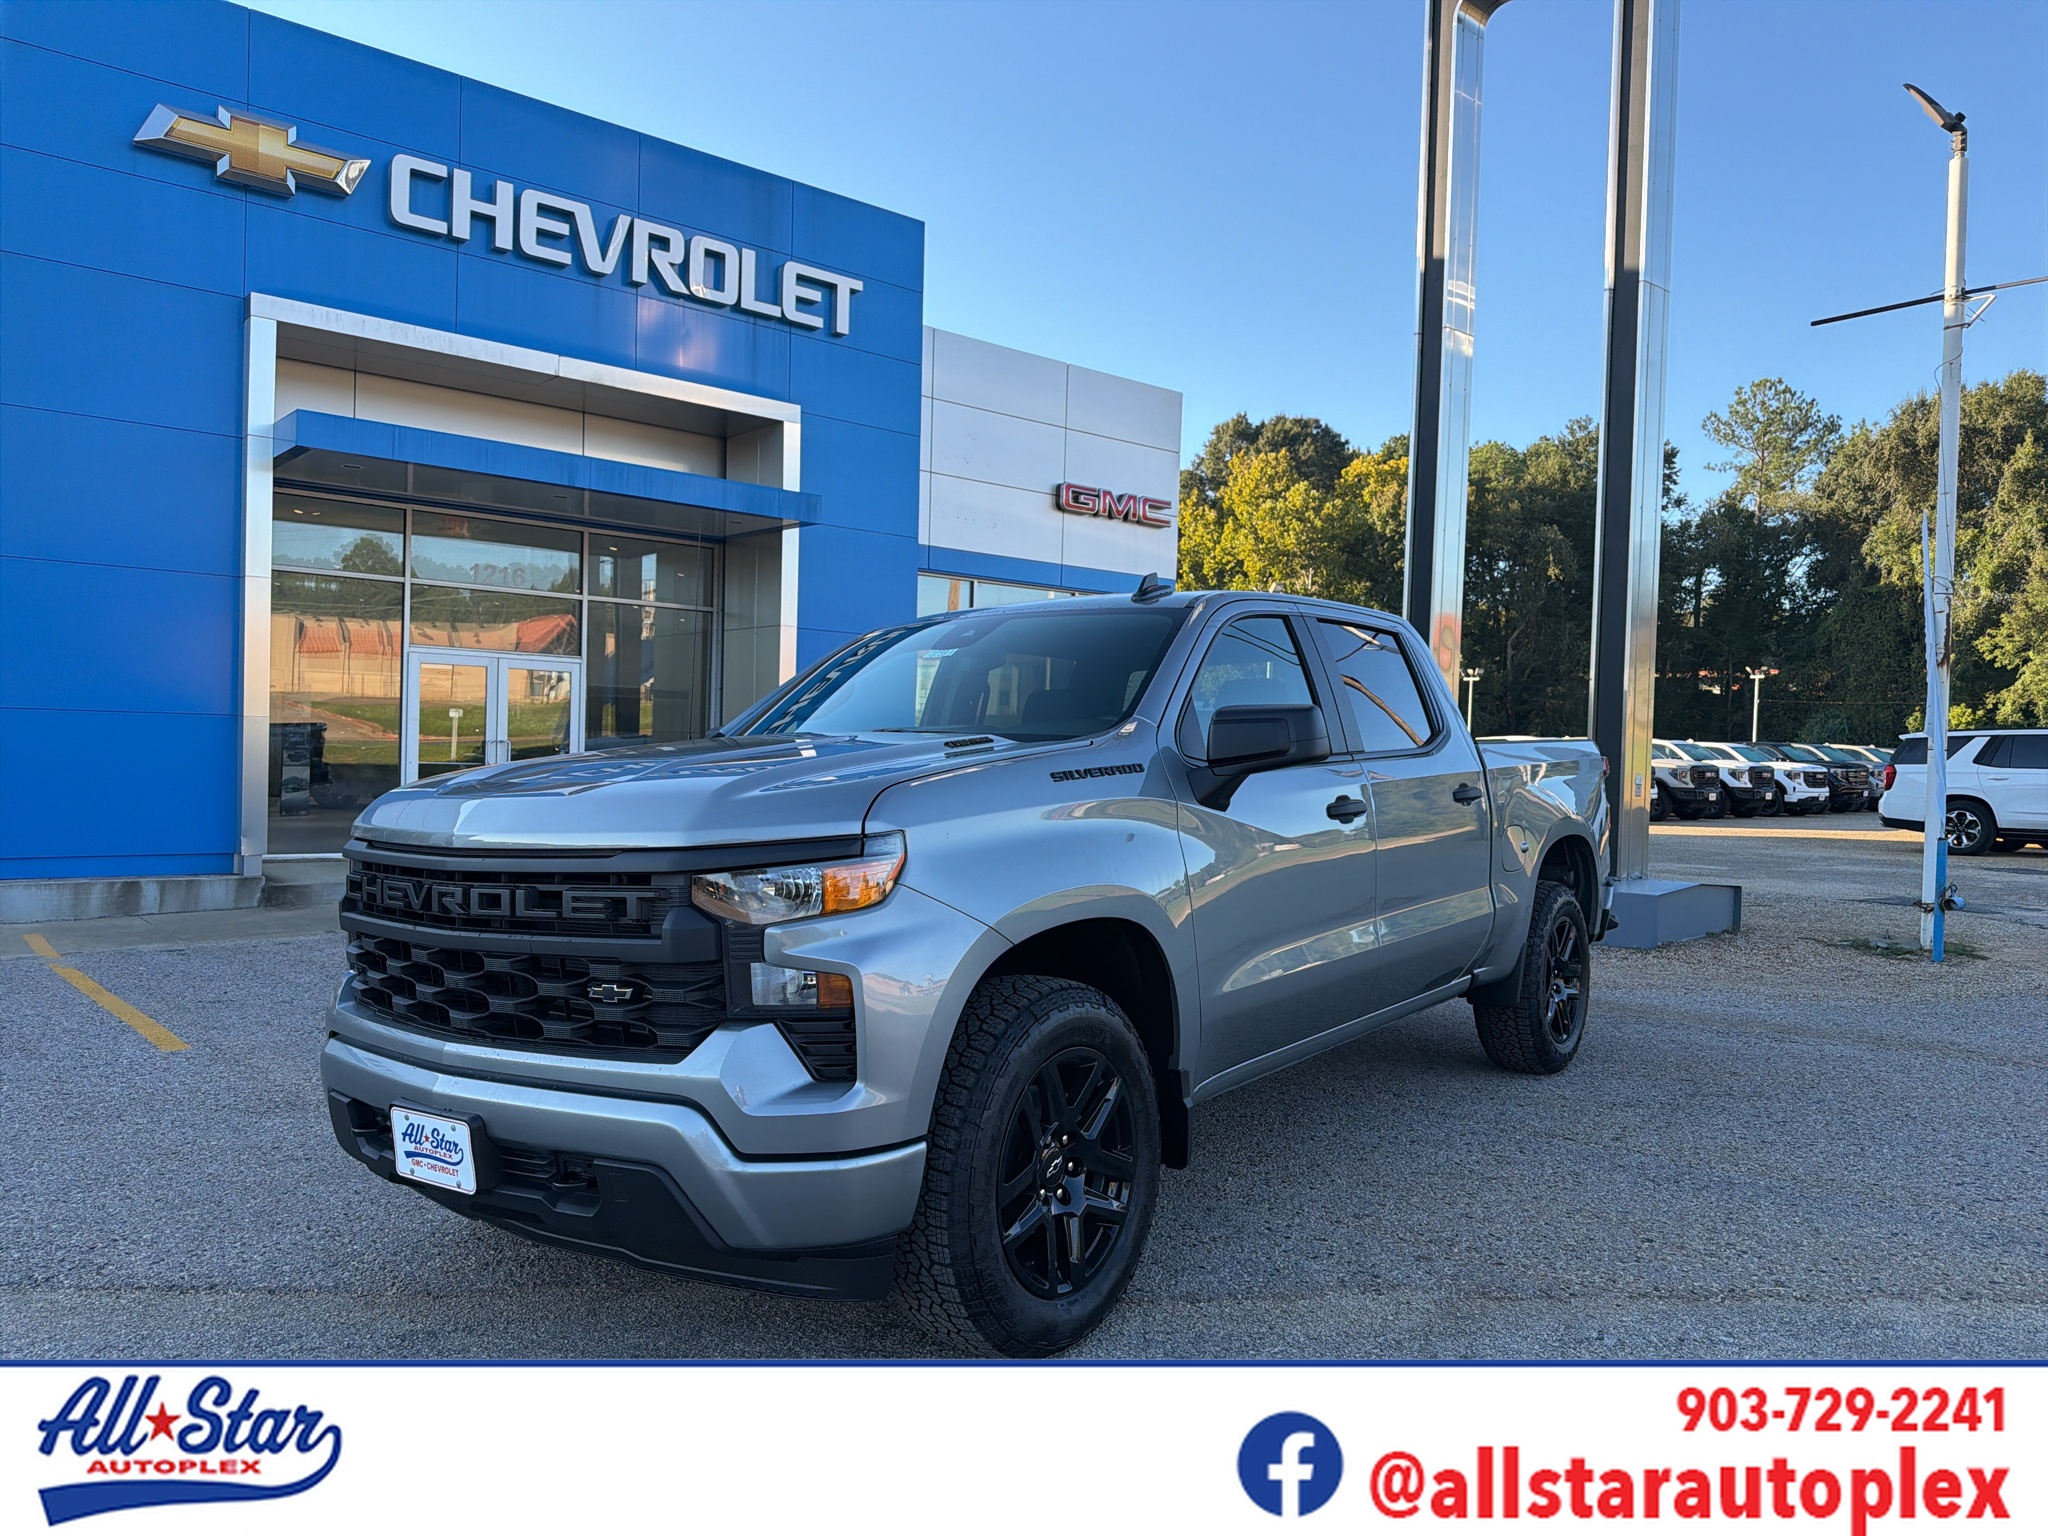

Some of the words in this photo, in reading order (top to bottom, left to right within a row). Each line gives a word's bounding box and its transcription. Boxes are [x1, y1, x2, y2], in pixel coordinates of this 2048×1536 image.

[388, 152, 865, 337] CHEVROLET
[1056, 481, 1172, 529] GMC
[469, 562, 527, 587] 1216
[1049, 762, 1146, 783] SILVERADO
[346, 873, 668, 924] CHEVROLET
[401, 1122, 426, 1146] All
[430, 1127, 461, 1155] Star
[413, 1145, 454, 1160] AUTOPLEX
[411, 1158, 424, 1168] GMC
[426, 1162, 459, 1178] CHEVROLET
